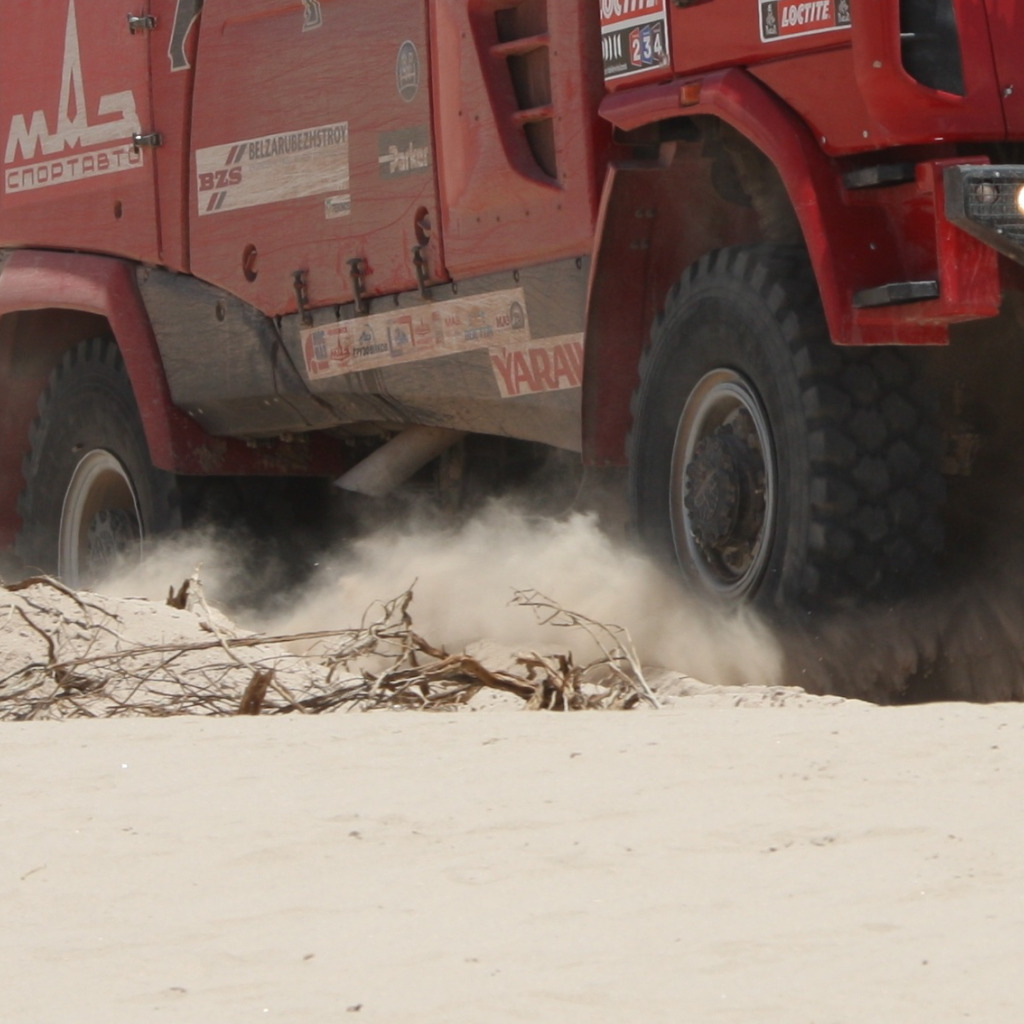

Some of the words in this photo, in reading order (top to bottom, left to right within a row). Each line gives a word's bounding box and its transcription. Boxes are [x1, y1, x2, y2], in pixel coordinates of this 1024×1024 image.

[781, 0, 830, 27] LOCTITE
[632, 39, 641, 62] 2
[643, 36, 652, 59] 3
[654, 33, 662, 56] 4
[248, 128, 348, 160] BELZARUBEZHSTROY
[7, 148, 141, 189] СПОРТАВТО
[199, 166, 243, 193] BZS
